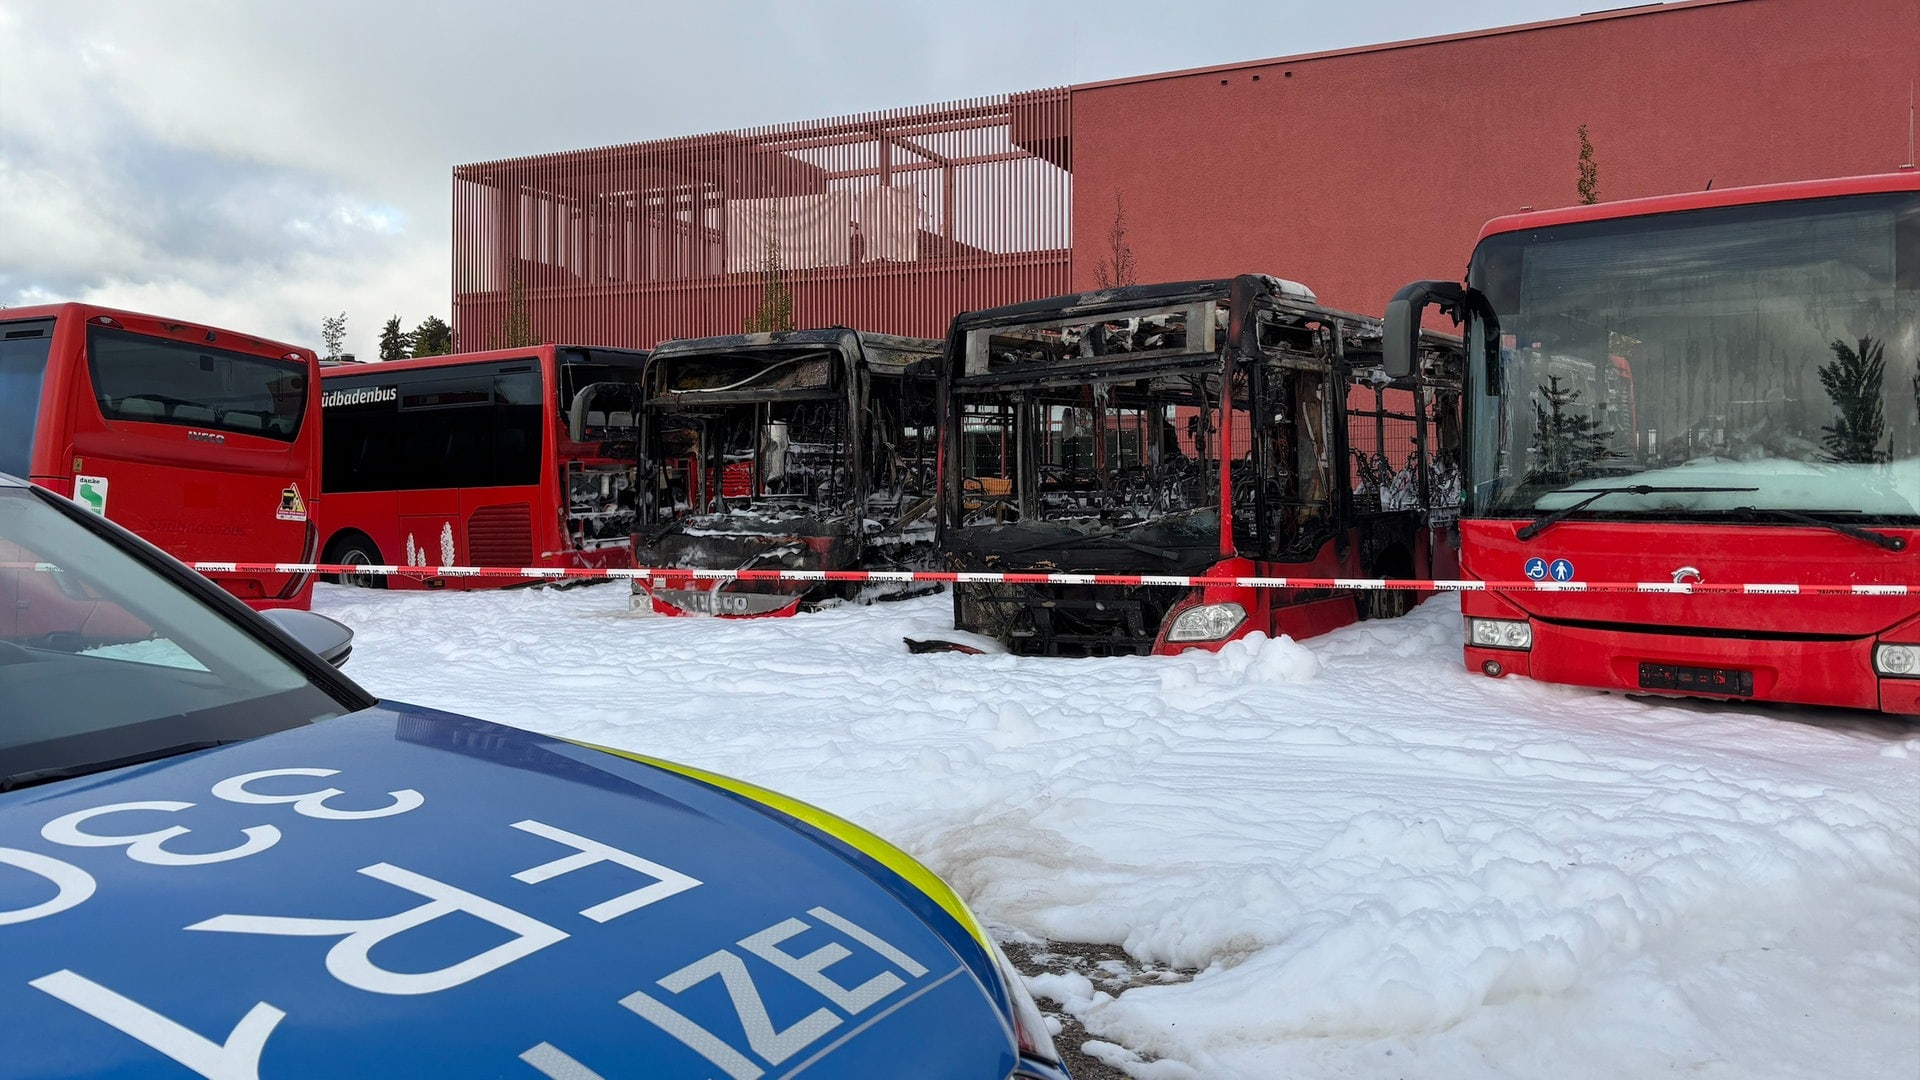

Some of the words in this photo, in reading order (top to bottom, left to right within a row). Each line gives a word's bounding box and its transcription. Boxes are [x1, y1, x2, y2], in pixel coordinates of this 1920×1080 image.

[321, 386, 397, 408] üdbadenbus
[188, 430, 225, 444] IVECO
[80, 477, 101, 485] danke
[518, 905, 930, 1080] IZEI
